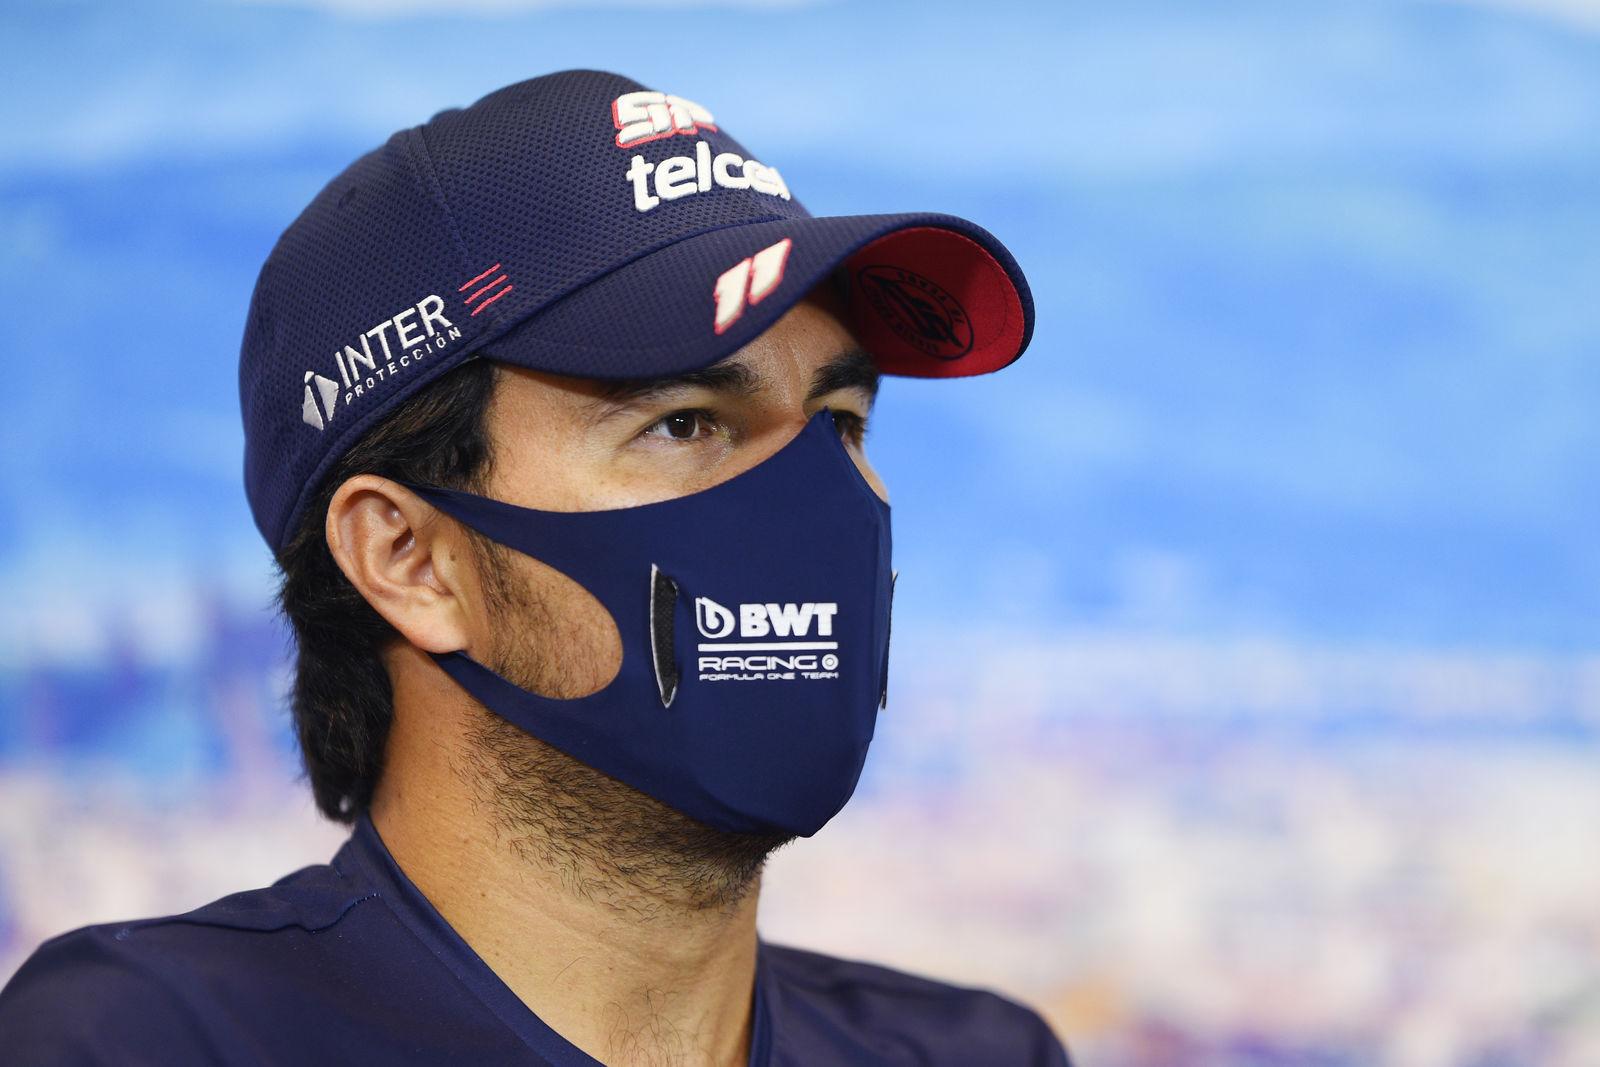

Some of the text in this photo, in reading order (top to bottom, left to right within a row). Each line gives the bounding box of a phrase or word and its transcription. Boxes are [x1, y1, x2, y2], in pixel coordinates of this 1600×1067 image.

[713, 237, 792, 335] 11
[334, 294, 453, 390] INTER
[344, 326, 462, 406] PROTECCIÓN
[739, 602, 838, 638] BWT
[698, 655, 818, 671] RACING
[698, 671, 839, 682] FORMULA ONE TEAM
